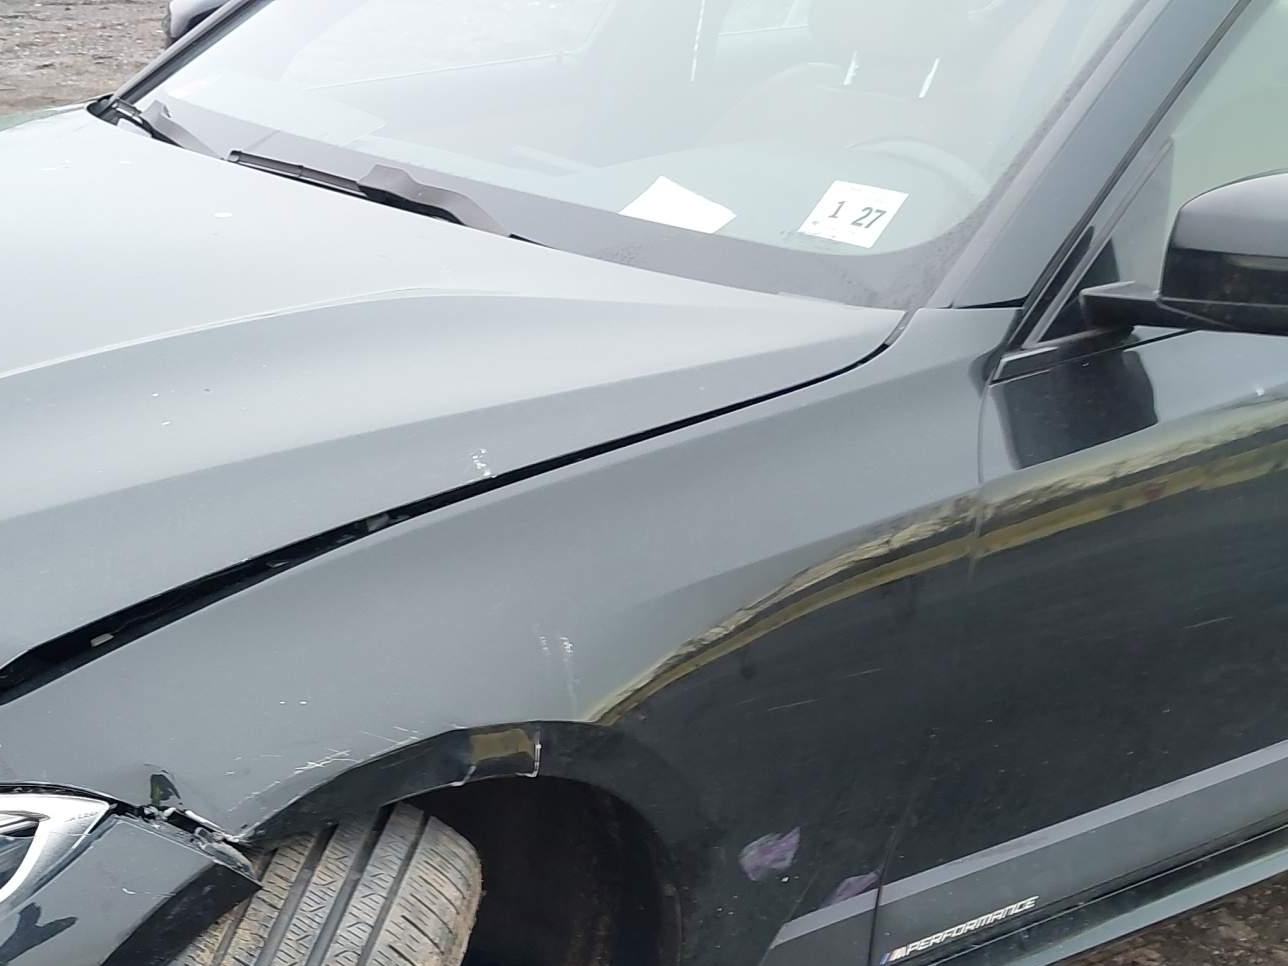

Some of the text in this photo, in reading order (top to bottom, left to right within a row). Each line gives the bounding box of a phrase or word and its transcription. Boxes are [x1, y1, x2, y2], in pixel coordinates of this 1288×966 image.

[828, 200, 887, 229] 1 27
[905, 895, 1040, 956] PERFORMANCE
